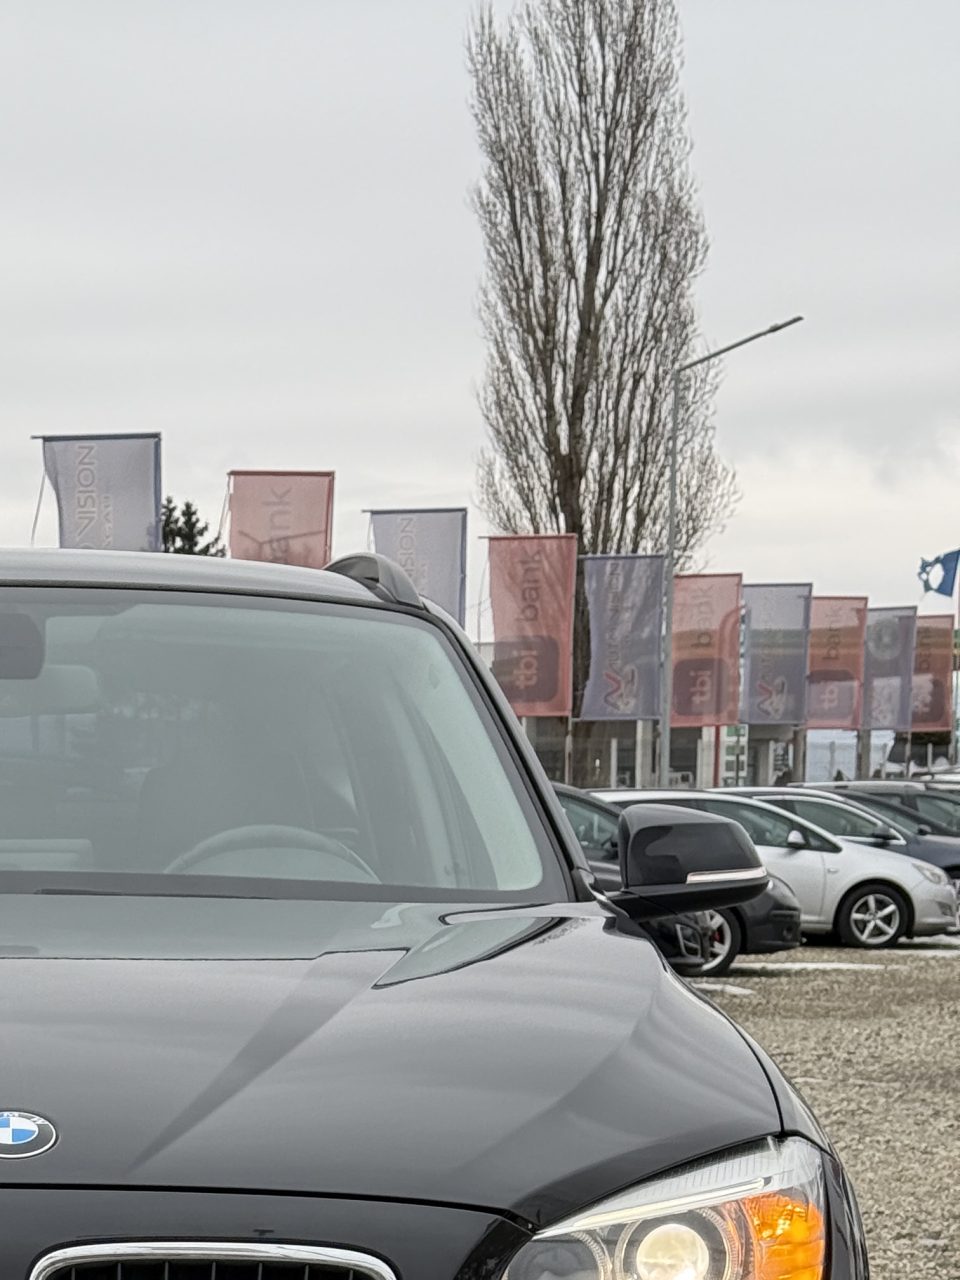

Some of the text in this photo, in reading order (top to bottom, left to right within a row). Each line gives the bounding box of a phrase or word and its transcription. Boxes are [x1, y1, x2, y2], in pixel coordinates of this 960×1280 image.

[77, 444, 97, 539] VISION
[262, 486, 292, 560] ank
[513, 550, 542, 690] tbi bank
